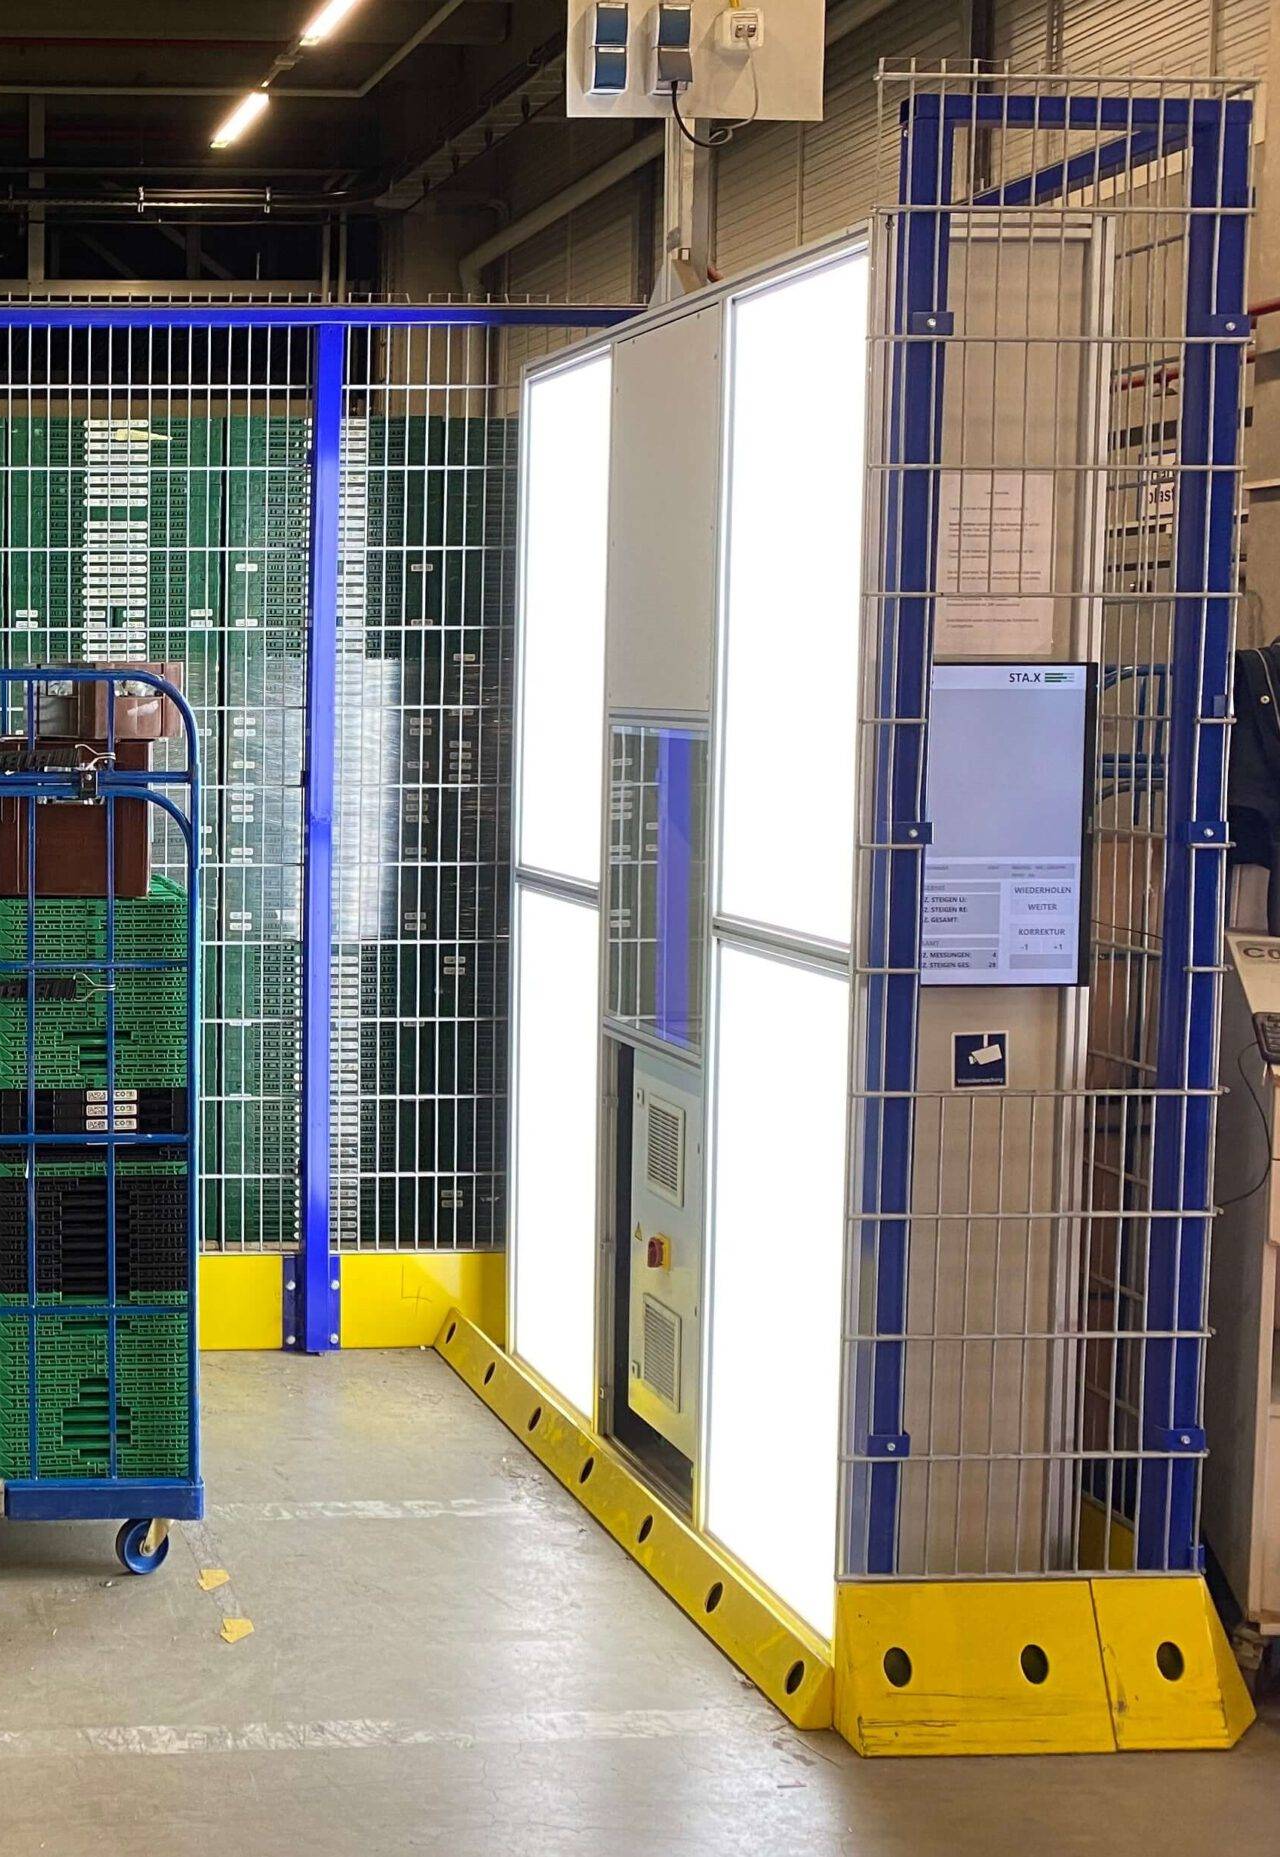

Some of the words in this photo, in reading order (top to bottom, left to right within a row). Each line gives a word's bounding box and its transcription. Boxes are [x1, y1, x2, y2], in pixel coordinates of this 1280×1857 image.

[1009, 672, 1041, 683] STA.X
[1014, 886, 1072, 894] WIEDERHOLEN
[1028, 903, 1058, 911] WEITER
[1018, 928, 1066, 936] KORREKTUR
